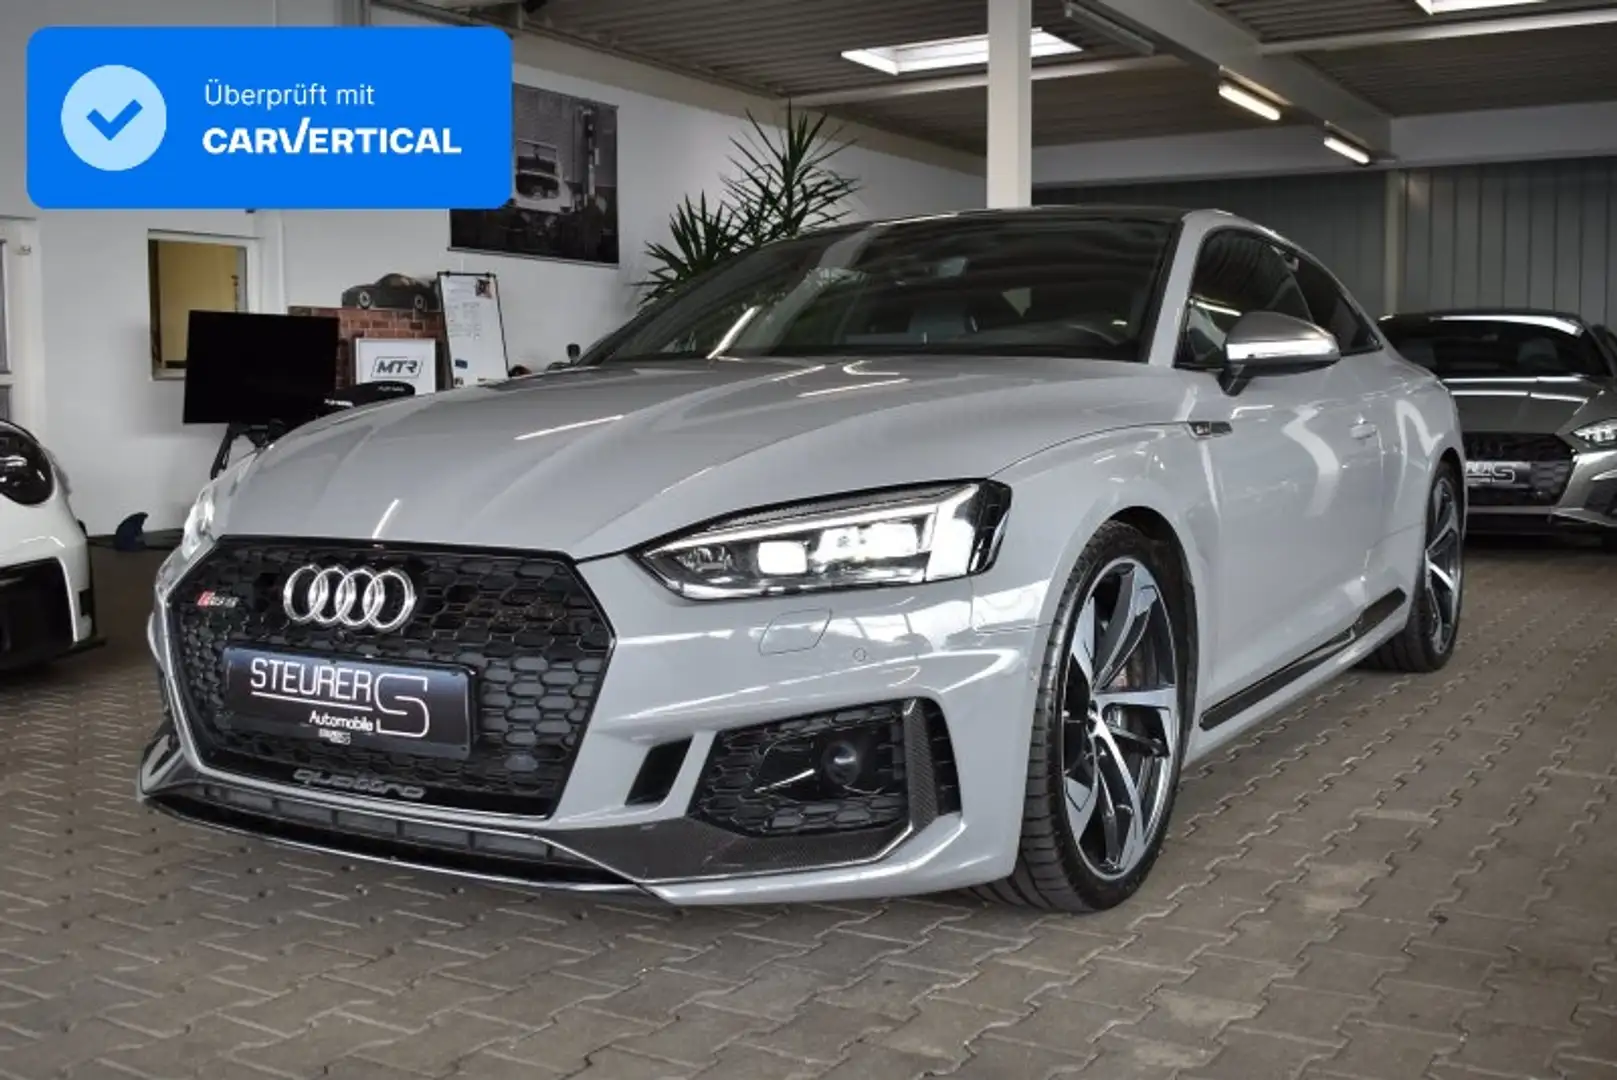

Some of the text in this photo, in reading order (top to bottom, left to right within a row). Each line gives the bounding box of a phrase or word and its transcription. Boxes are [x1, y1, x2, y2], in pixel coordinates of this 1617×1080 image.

[376, 359, 418, 374] MTR
[250, 657, 373, 703] STEURER
[308, 709, 374, 733] Automobile
